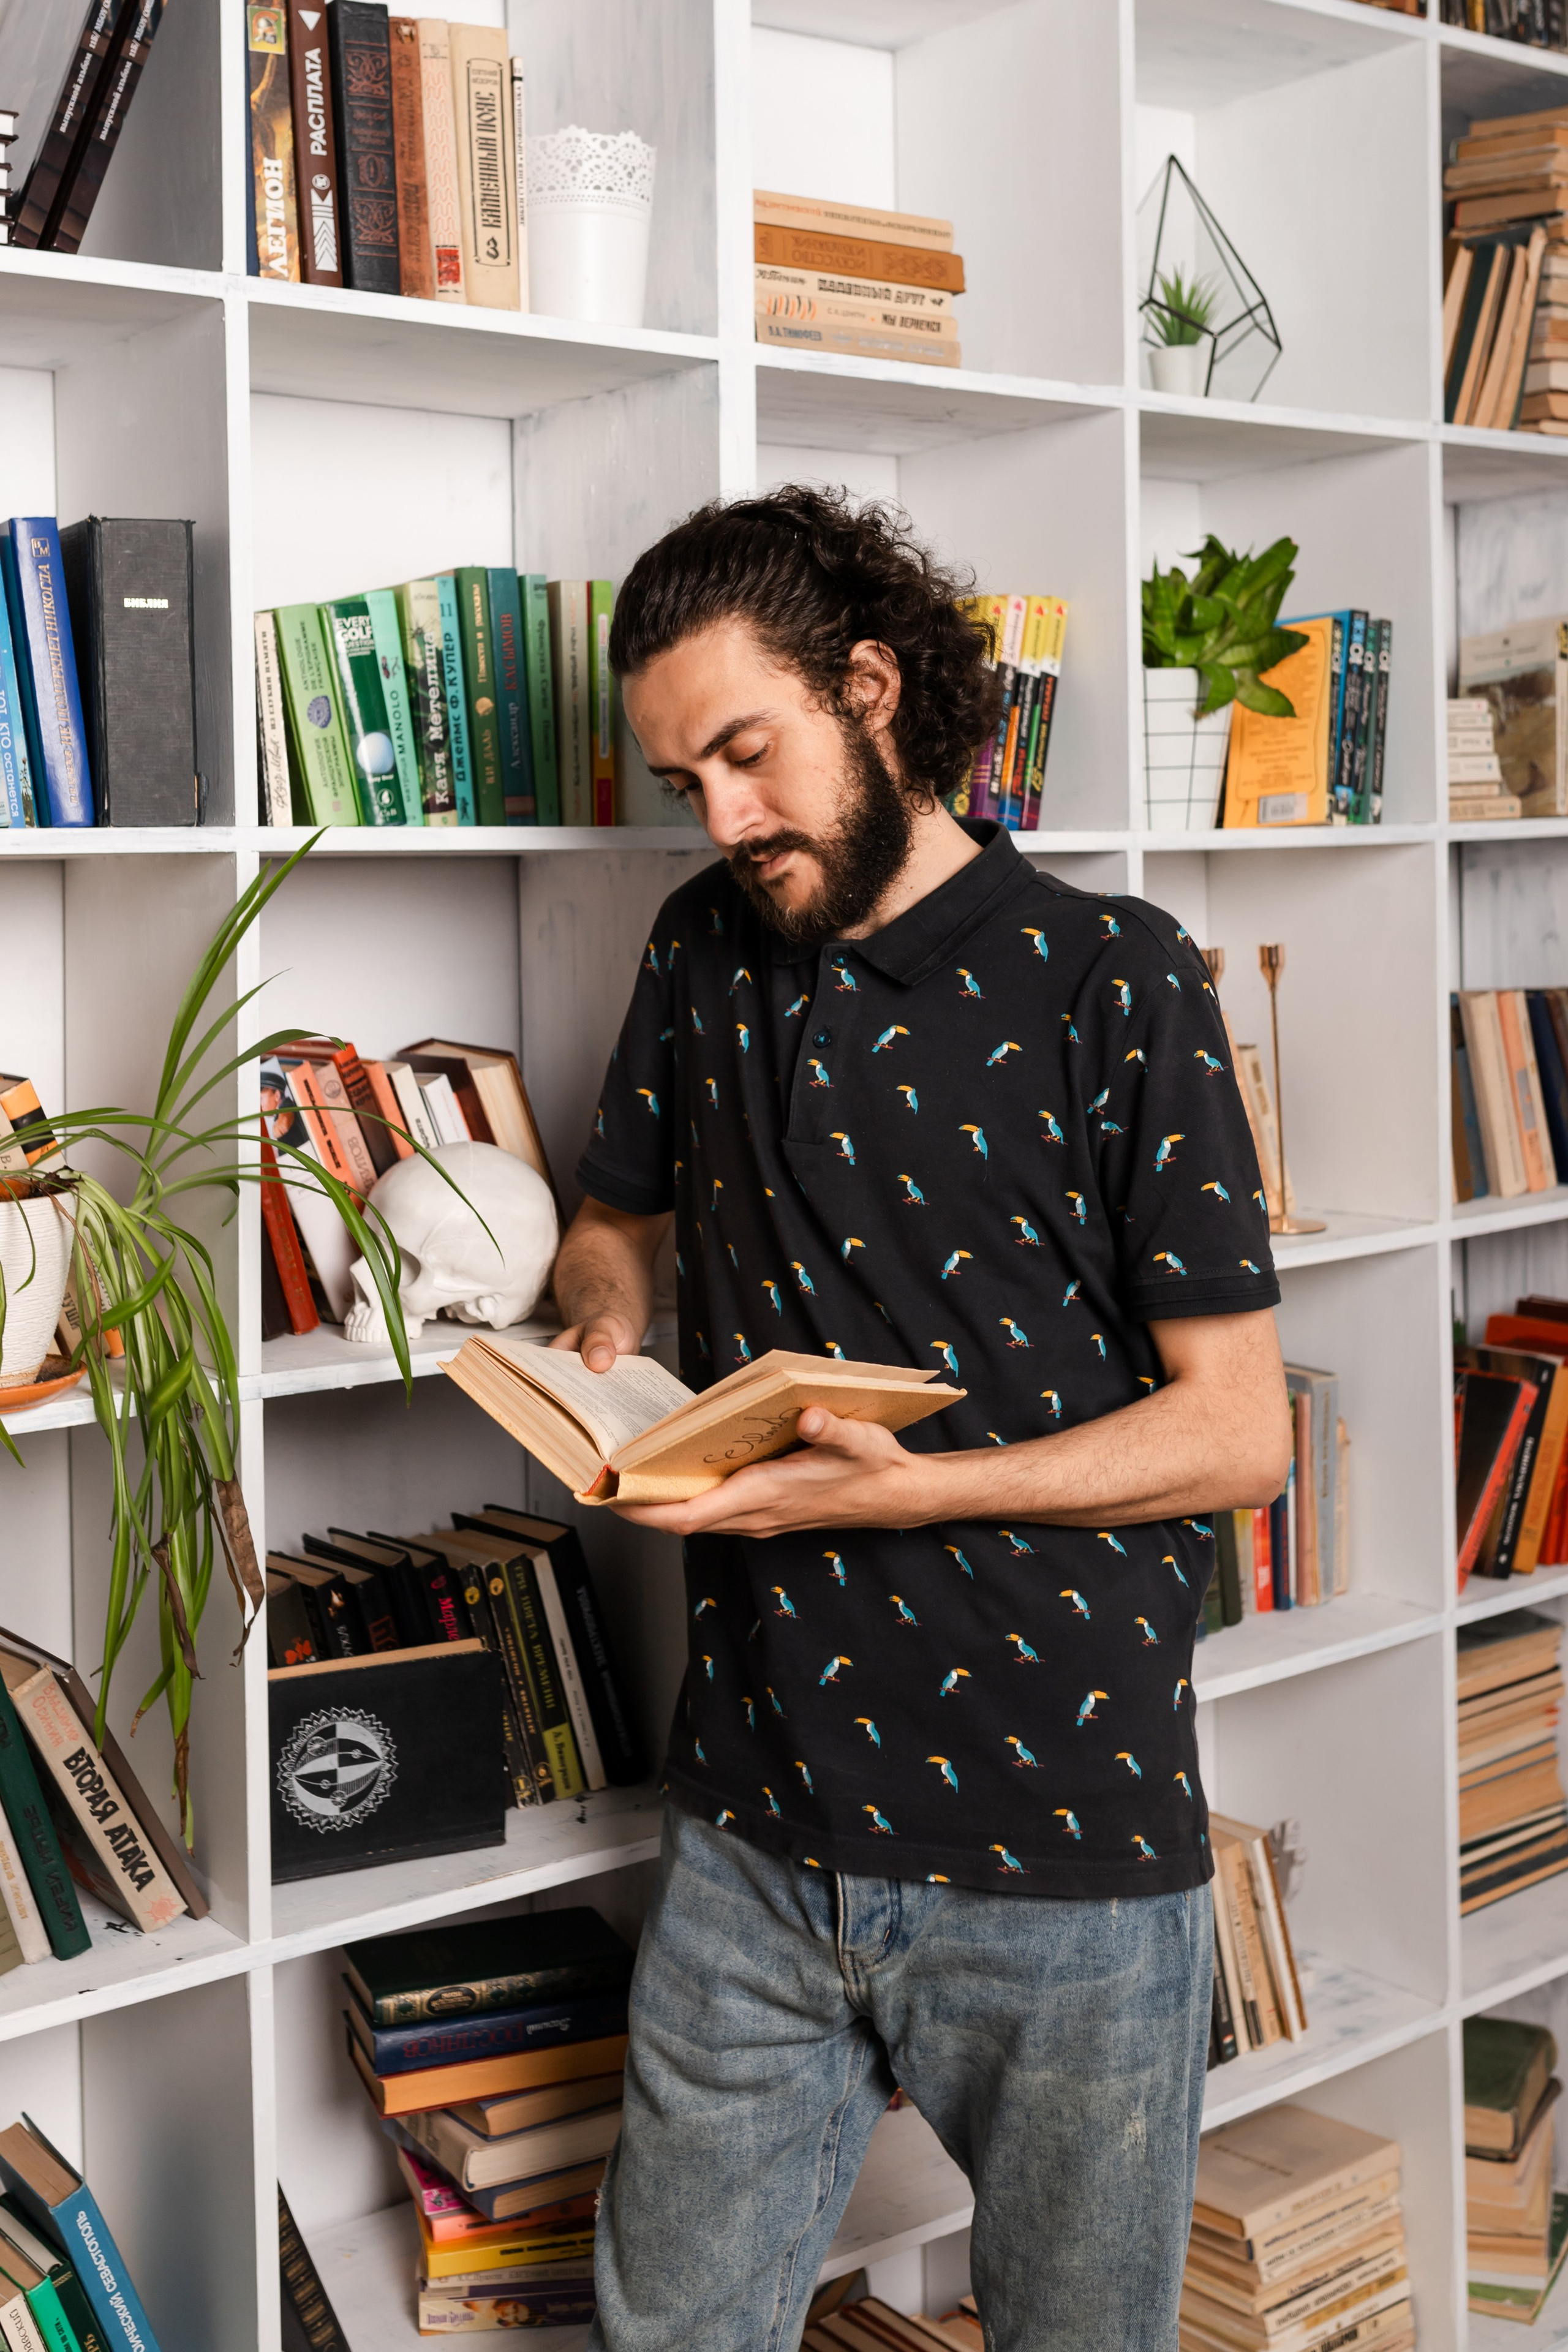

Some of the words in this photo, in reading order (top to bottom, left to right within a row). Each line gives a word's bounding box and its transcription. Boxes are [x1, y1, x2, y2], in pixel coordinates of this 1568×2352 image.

[60, 83, 81, 133] выпускной
[77, 53, 92, 85] альбом
[100, 91, 121, 141] выпускной
[117, 61, 132, 92] альбом
[305, 48, 328, 156] РАСПЛАТА
[475, 91, 497, 134] ПОЯС
[476, 136, 502, 229] КАМЕННЫЙ
[262, 157, 288, 277] ЛЕГИОН
[39, 564, 60, 630] НИКОГДА
[123, 598, 168, 609] БИБЛИЯ
[336, 615, 371, 630] EVERY
[339, 626, 372, 644] GOLF
[500, 613, 518, 691] КАСЫМОВ
[48, 632, 70, 722] ПОМЕРКНЕТ
[424, 631, 443, 741] Метелица
[0, 722, 12, 749] КТО
[59, 725, 74, 745] НЕ
[390, 689, 407, 755] MANOLO
[450, 715, 466, 782] Джеймс
[508, 702, 521, 771] Александр
[4, 752, 19, 818] останется
[434, 752, 449, 805] Катя
[521, 1596, 538, 1640] ЦВЕТА
[532, 1643, 556, 1709] ВРЕМЕНИ
[32, 1695, 64, 1748] Осинин
[42, 1682, 80, 1742] Владимир
[63, 1746, 119, 1824] ВТОРАЯ
[104, 1820, 156, 1893] АТАКА
[77, 2210, 118, 2293] СЕВАСТОПОЛЬ
